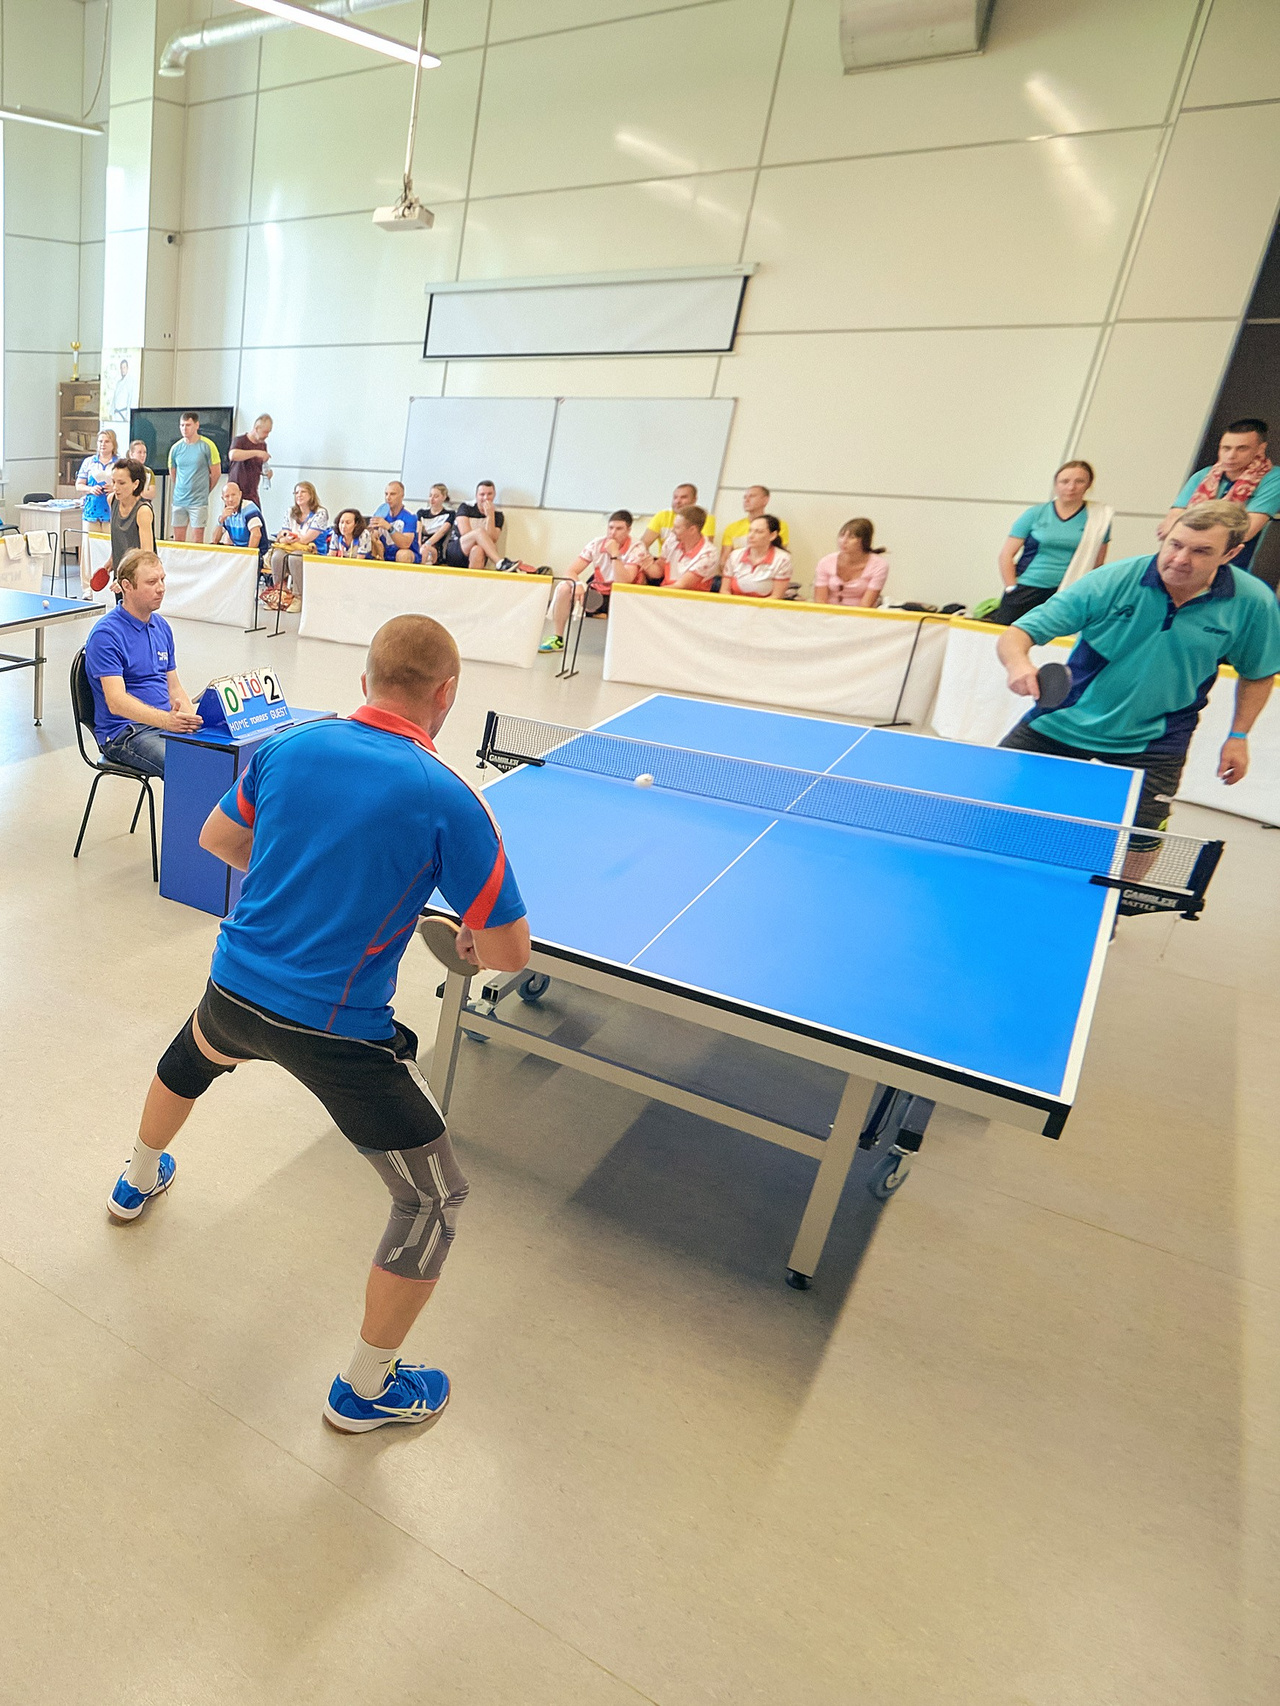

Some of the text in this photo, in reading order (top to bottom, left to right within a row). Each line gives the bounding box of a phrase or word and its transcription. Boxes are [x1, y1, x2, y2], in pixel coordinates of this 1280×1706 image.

[224, 675, 280, 713] 0 1 0 2
[230, 718, 249, 732] HOME
[270, 706, 288, 719] GUEST
[1121, 900, 1156, 911] BATTLE
